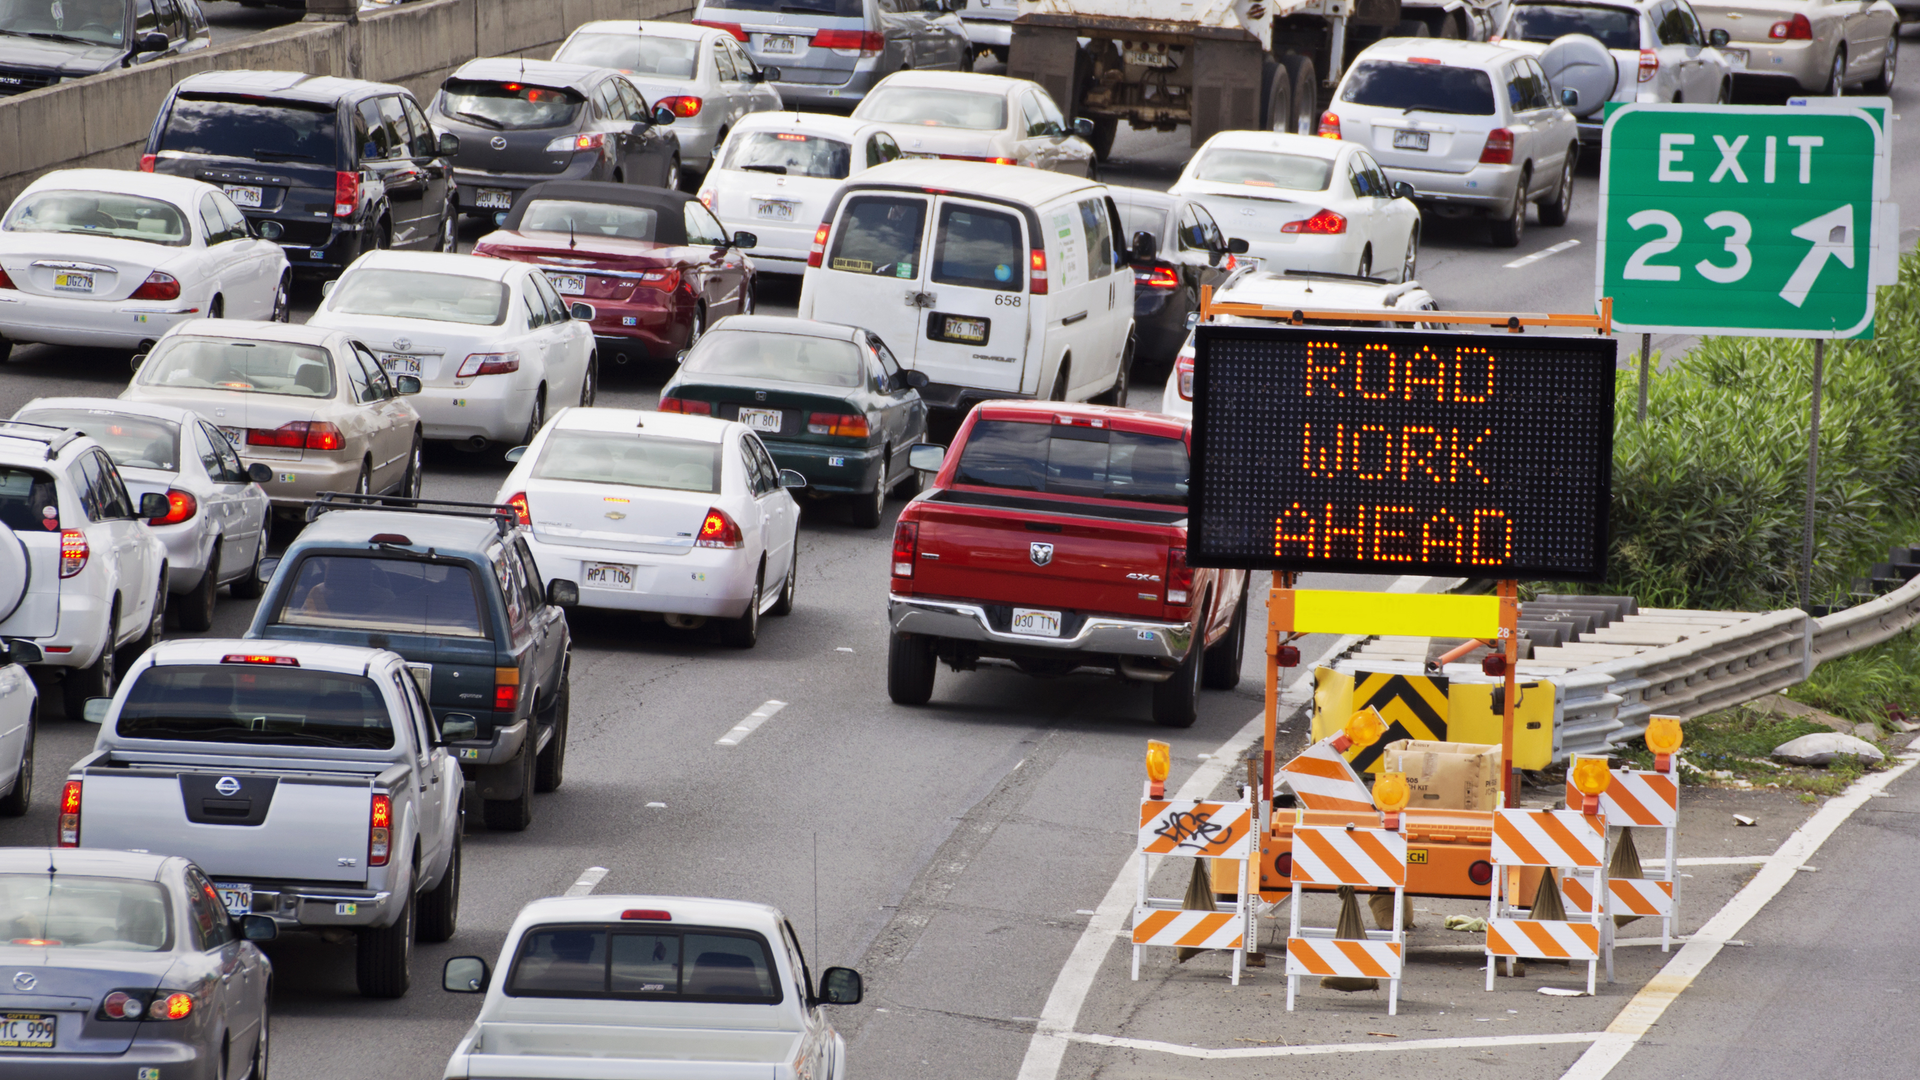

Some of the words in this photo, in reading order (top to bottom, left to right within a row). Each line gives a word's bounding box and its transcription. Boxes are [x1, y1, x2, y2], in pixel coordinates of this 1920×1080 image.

[1658, 133, 1824, 183] EXIT
[244, 190, 261, 203] 983
[1622, 209, 1753, 284] 23
[846, 260, 862, 269] WOULD
[568, 278, 584, 290] 950
[994, 295, 1022, 308] 658
[945, 320, 962, 334] 376
[405, 359, 421, 373] 164
[973, 354, 1017, 363] CHEVROLET
[1305, 341, 1495, 404] ROAD
[740, 412, 757, 426] NYT
[763, 413, 780, 428] 801
[1302, 422, 1491, 484] WORK
[1275, 502, 1513, 566] AHEAD
[587, 568, 606, 583] RPA
[612, 569, 631, 584] 106
[1126, 573, 1161, 582] 4X4
[1014, 614, 1034, 629] 030
[1041, 616, 1059, 631] TTV
[1497, 627, 1510, 638] 28
[337, 857, 357, 868] SE
[225, 891, 249, 908] 570
[27, 1023, 54, 1043] 999
